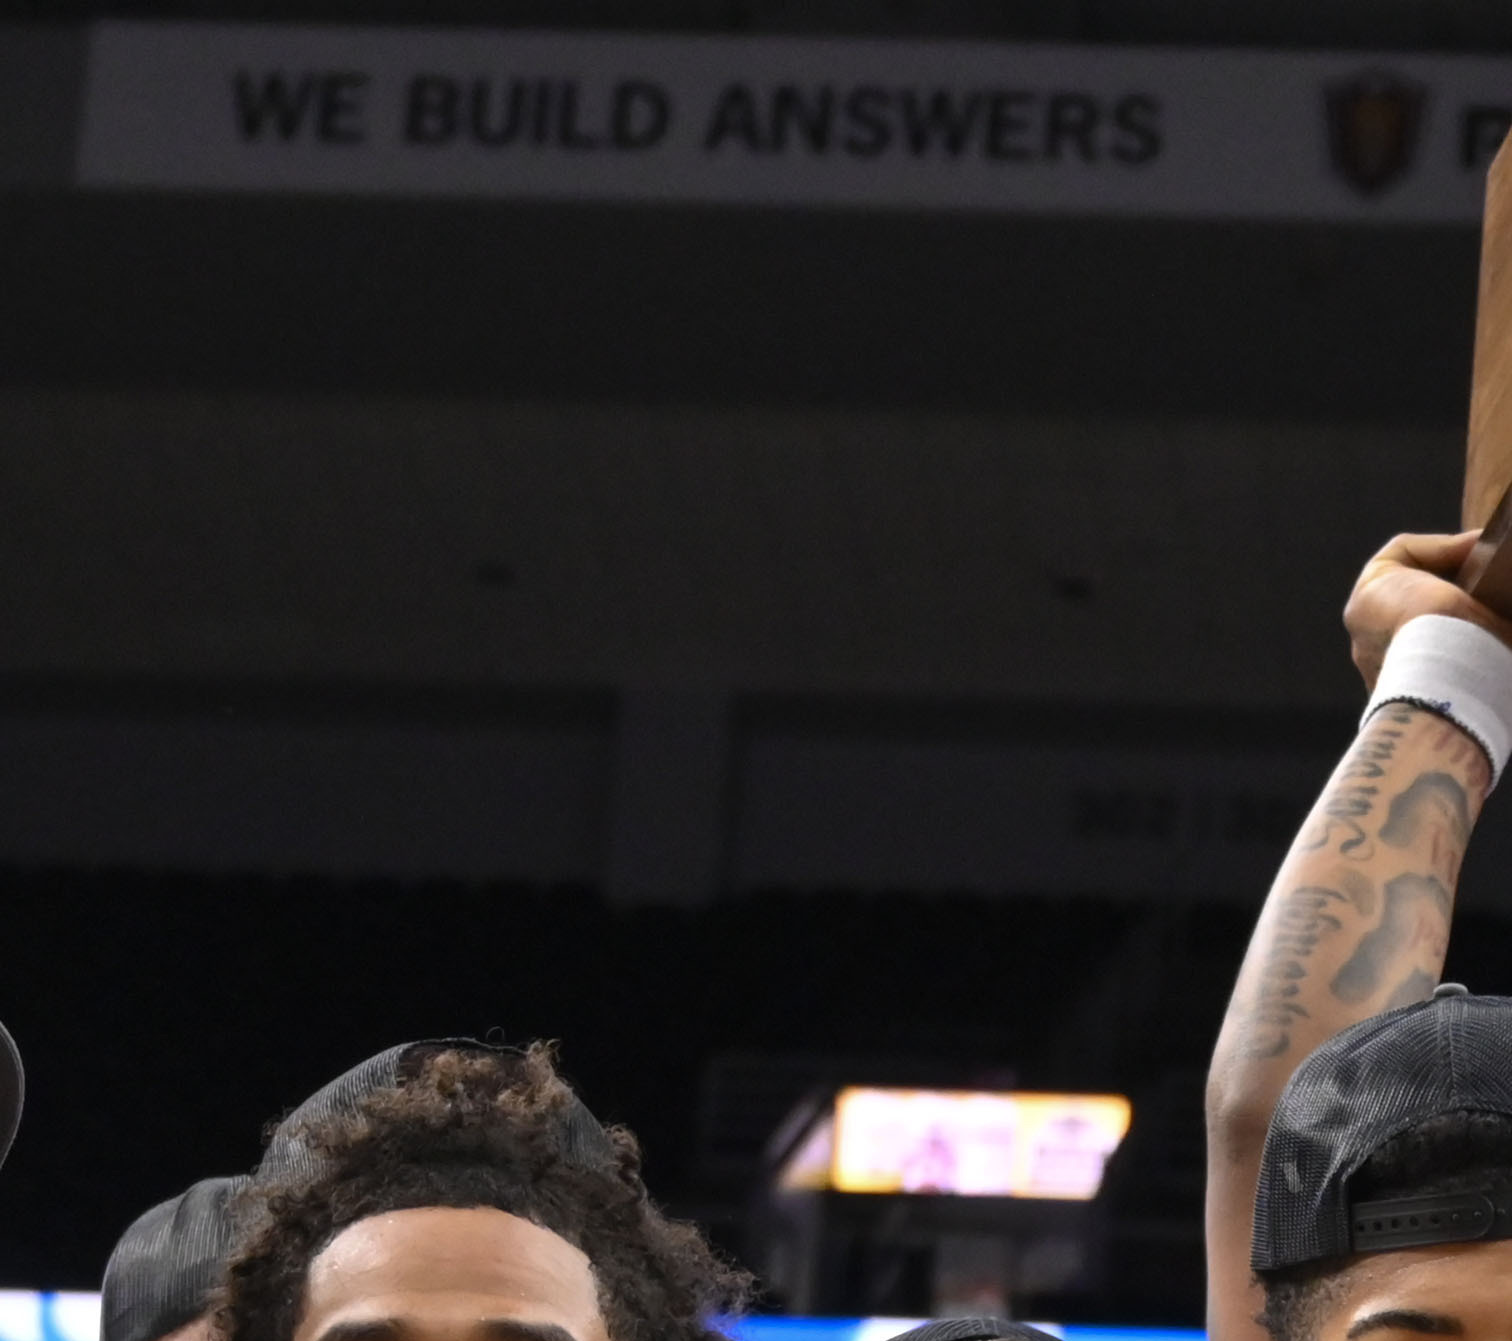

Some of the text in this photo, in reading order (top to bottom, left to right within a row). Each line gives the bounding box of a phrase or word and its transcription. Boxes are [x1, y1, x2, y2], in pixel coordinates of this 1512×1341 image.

[235, 70, 1166, 167] WE BUILD ANSWERS
